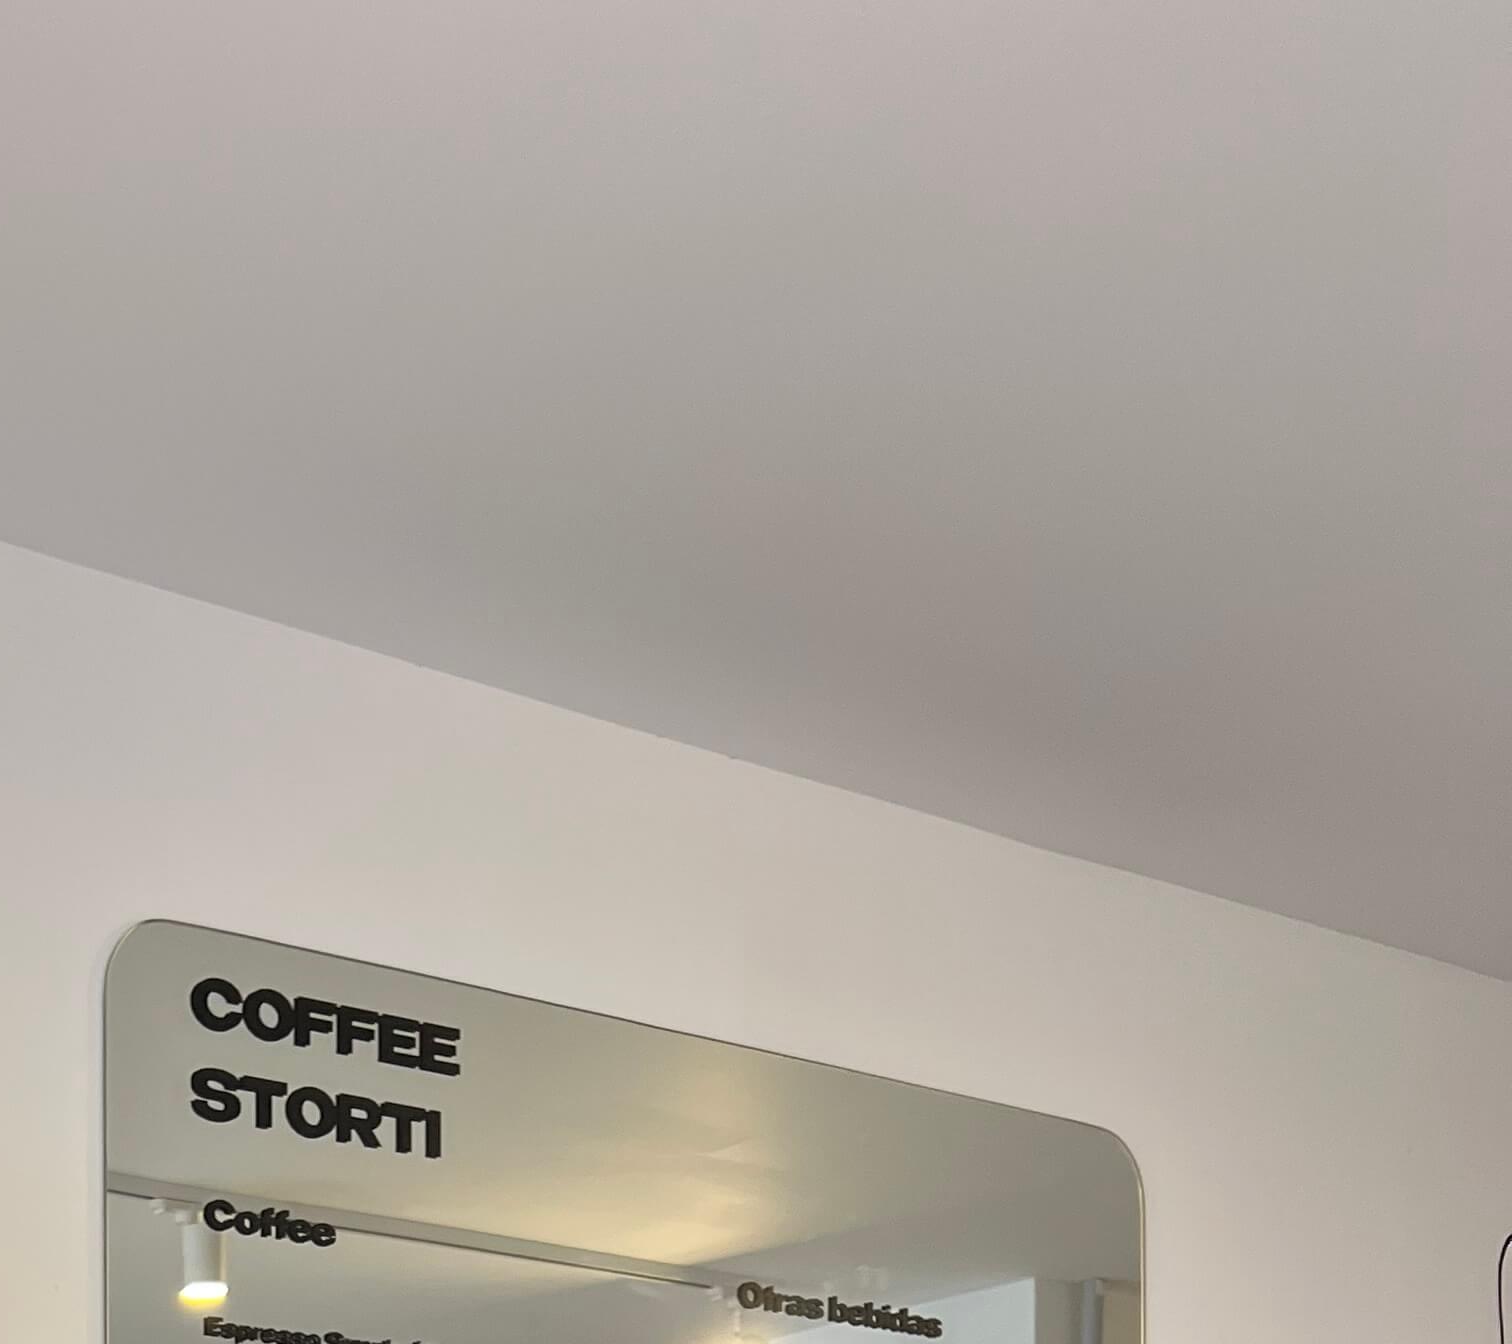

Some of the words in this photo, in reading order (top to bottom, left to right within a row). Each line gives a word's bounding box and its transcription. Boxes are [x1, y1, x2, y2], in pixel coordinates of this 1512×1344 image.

[190, 977, 461, 1077] COFFEE
[190, 1067, 441, 1158] STORTI
[202, 1199, 337, 1248] Coffee
[738, 1281, 825, 1319] Otras
[827, 1296, 943, 1338] bebidas
